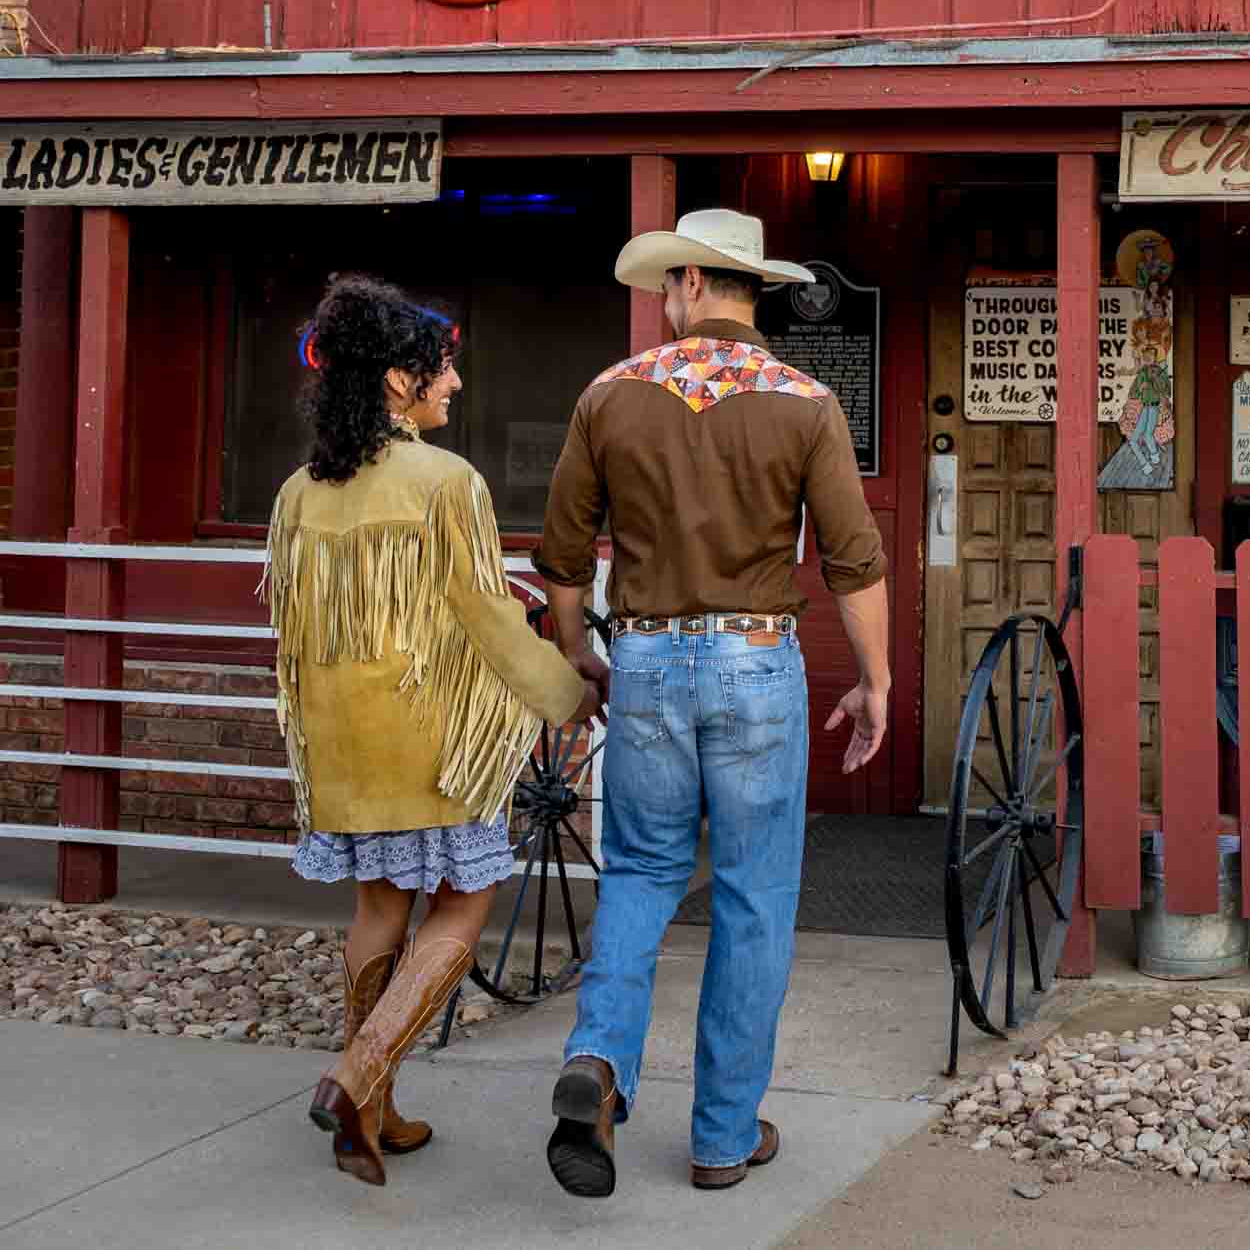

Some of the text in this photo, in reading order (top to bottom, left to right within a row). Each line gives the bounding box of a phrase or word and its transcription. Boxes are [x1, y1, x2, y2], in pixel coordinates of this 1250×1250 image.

[1, 131, 439, 191] LADIES & GENTLEMEN
[972, 318, 1028, 336] DOOR
[973, 339, 1020, 358] BEST
[970, 362, 1028, 380] MUSIC
[968, 384, 993, 404] in
[996, 384, 1040, 404] the
[1236, 438, 1249, 450] NO
